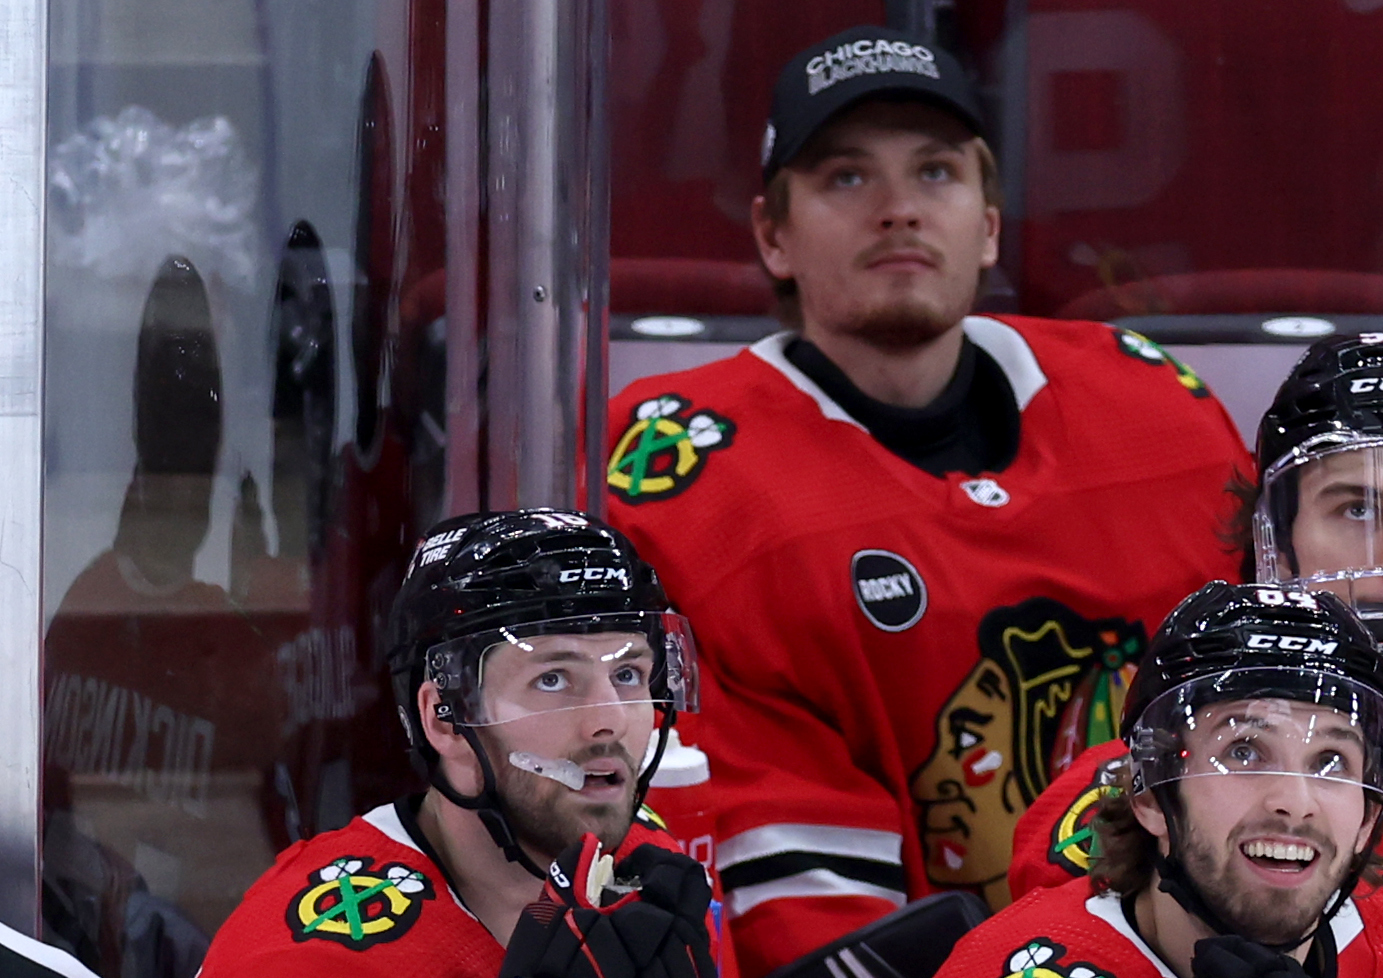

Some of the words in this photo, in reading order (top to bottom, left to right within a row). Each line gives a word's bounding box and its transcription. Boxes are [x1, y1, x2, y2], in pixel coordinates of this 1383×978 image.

[806, 39, 935, 74] CHICAGO
[421, 527, 467, 551] BELLE
[419, 545, 452, 567] TIRE
[558, 566, 627, 583] CCM
[858, 571, 914, 603] ROCKY
[1247, 634, 1339, 656] CCM
